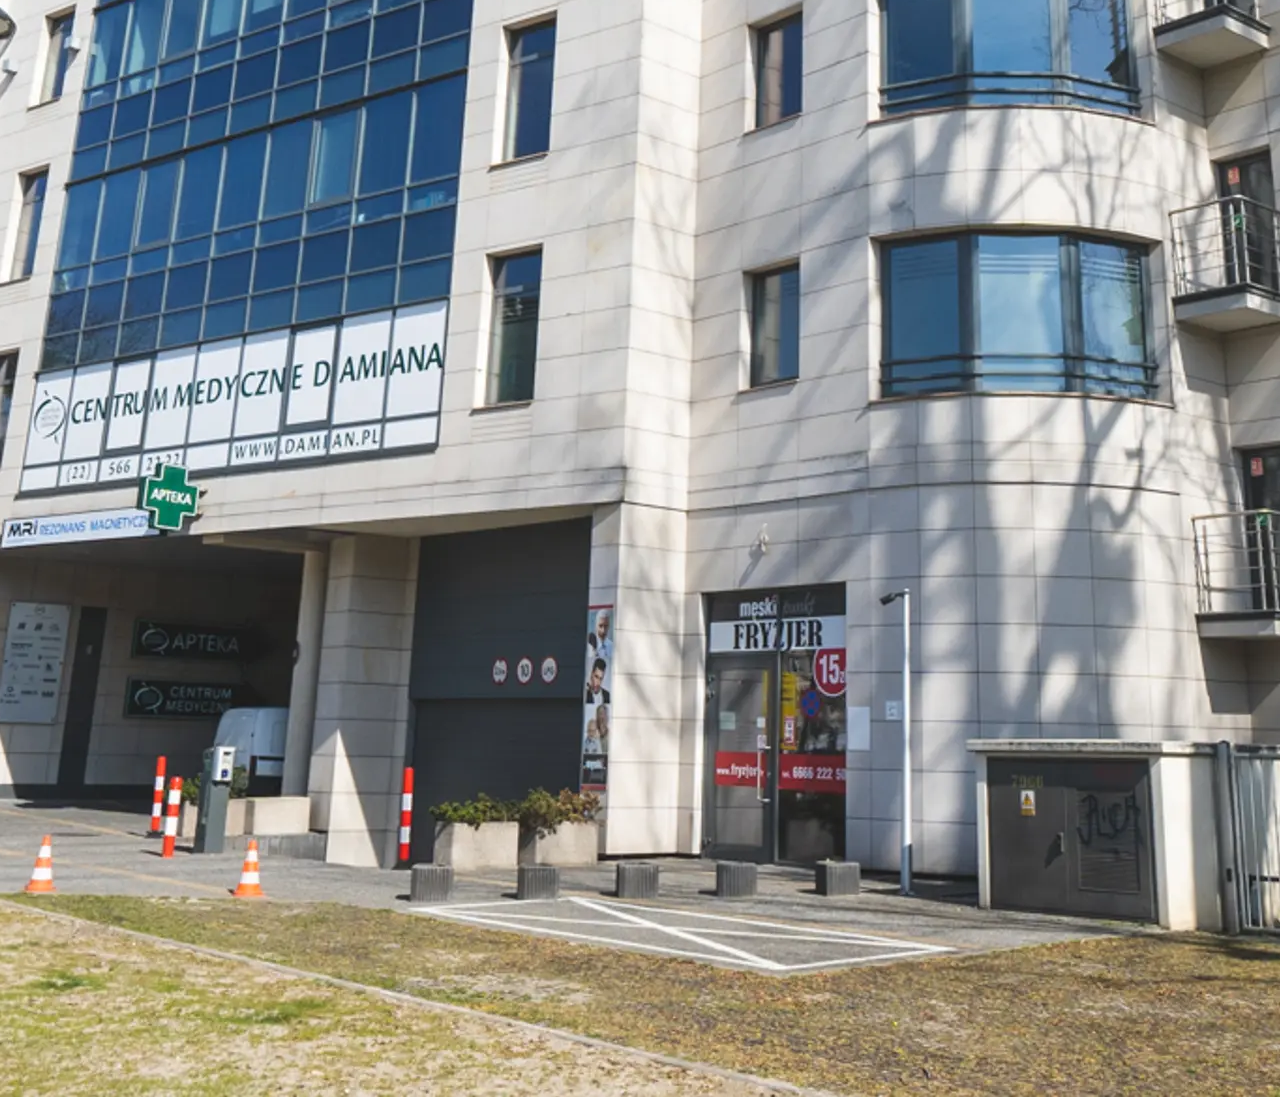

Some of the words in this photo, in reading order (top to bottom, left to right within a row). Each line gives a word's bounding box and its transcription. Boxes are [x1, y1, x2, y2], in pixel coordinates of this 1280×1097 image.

[71, 387, 168, 424] CENTRUM
[172, 364, 304, 409] MEDYCZNE
[313, 342, 444, 387] DAMIANA
[67, 463, 92, 482] (22)
[108, 460, 131, 476] 566
[150, 487, 193, 506] APTEKA
[40, 521, 86, 535] REZONANS
[172, 633, 240, 654] APTEKA
[733, 619, 823, 652] FRYZJER
[521, 664, 529, 678] 10
[170, 686, 232, 700] CENTRUM
